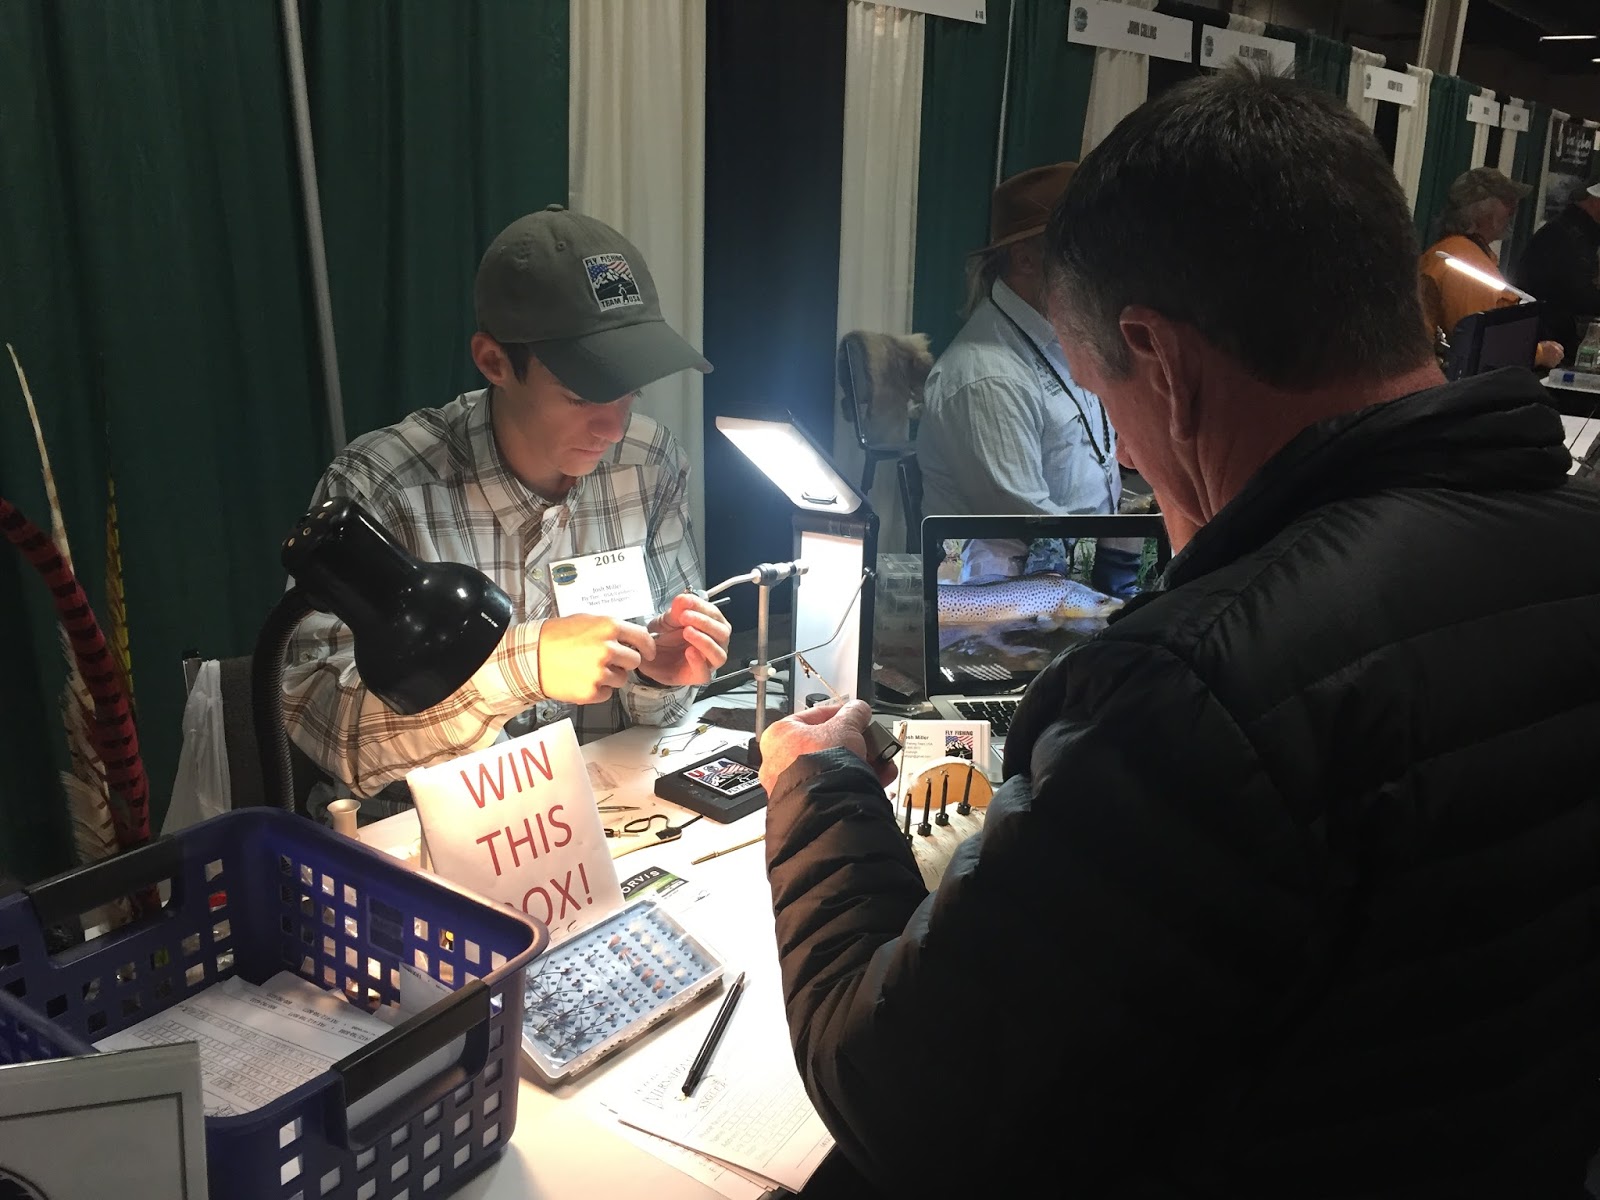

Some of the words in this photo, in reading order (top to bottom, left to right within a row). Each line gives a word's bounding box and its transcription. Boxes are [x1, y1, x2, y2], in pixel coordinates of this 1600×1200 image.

[585, 257, 597, 266] FLY
[601, 298, 622, 308] TEAM
[594, 552, 625, 567] 2016
[592, 586, 605, 594] Josh
[460, 740, 554, 809] WIN
[476, 804, 573, 877] THIS
[621, 870, 660, 894] ORVIS
[504, 862, 594, 927] OX!
